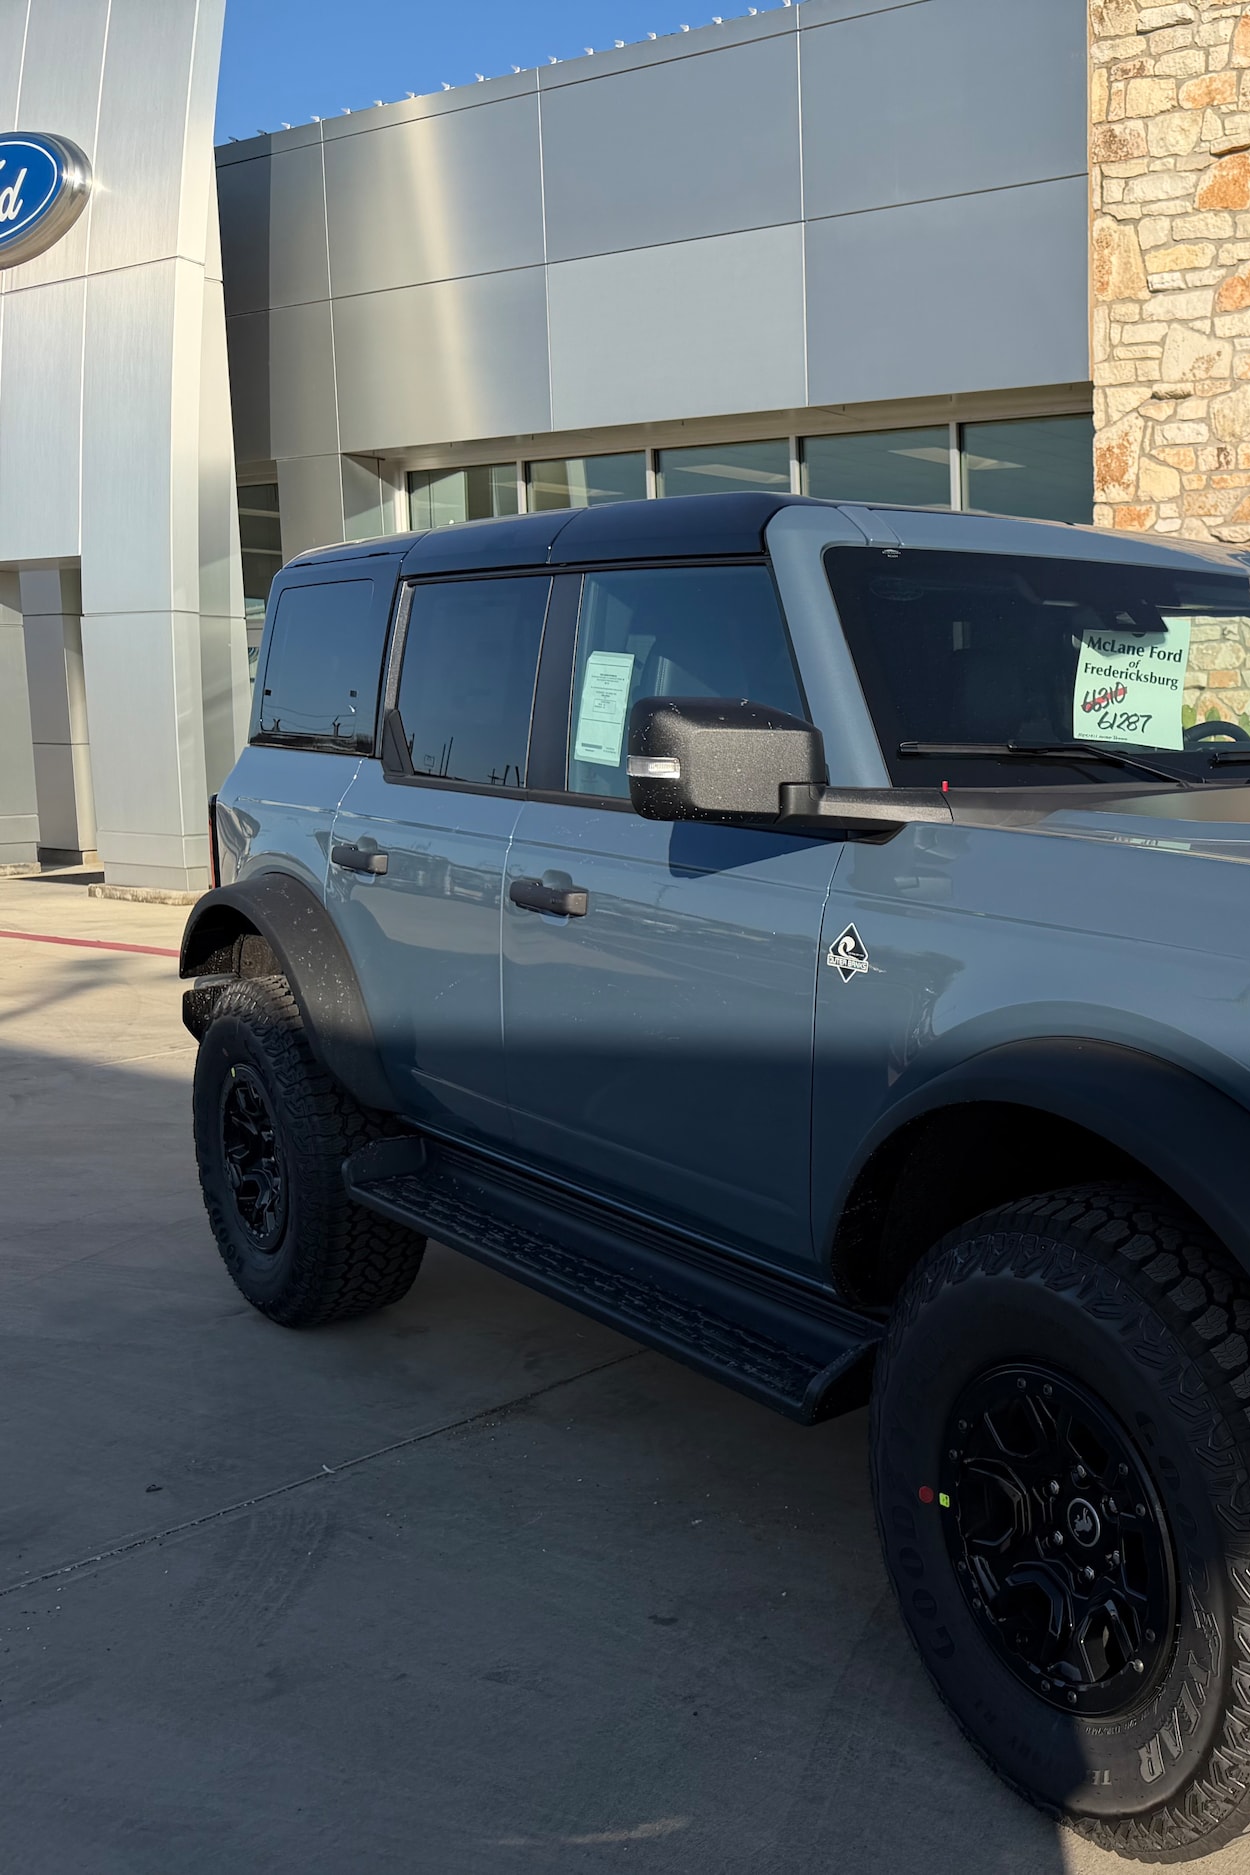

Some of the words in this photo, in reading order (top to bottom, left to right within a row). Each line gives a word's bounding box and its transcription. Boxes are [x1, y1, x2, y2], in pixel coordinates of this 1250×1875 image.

[1087, 636, 1145, 658] McLane
[1149, 646, 1182, 663] Ford
[1084, 662, 1179, 690] Fredericksburg
[1128, 660, 1141, 669] of
[1097, 711, 1152, 733] 61287
